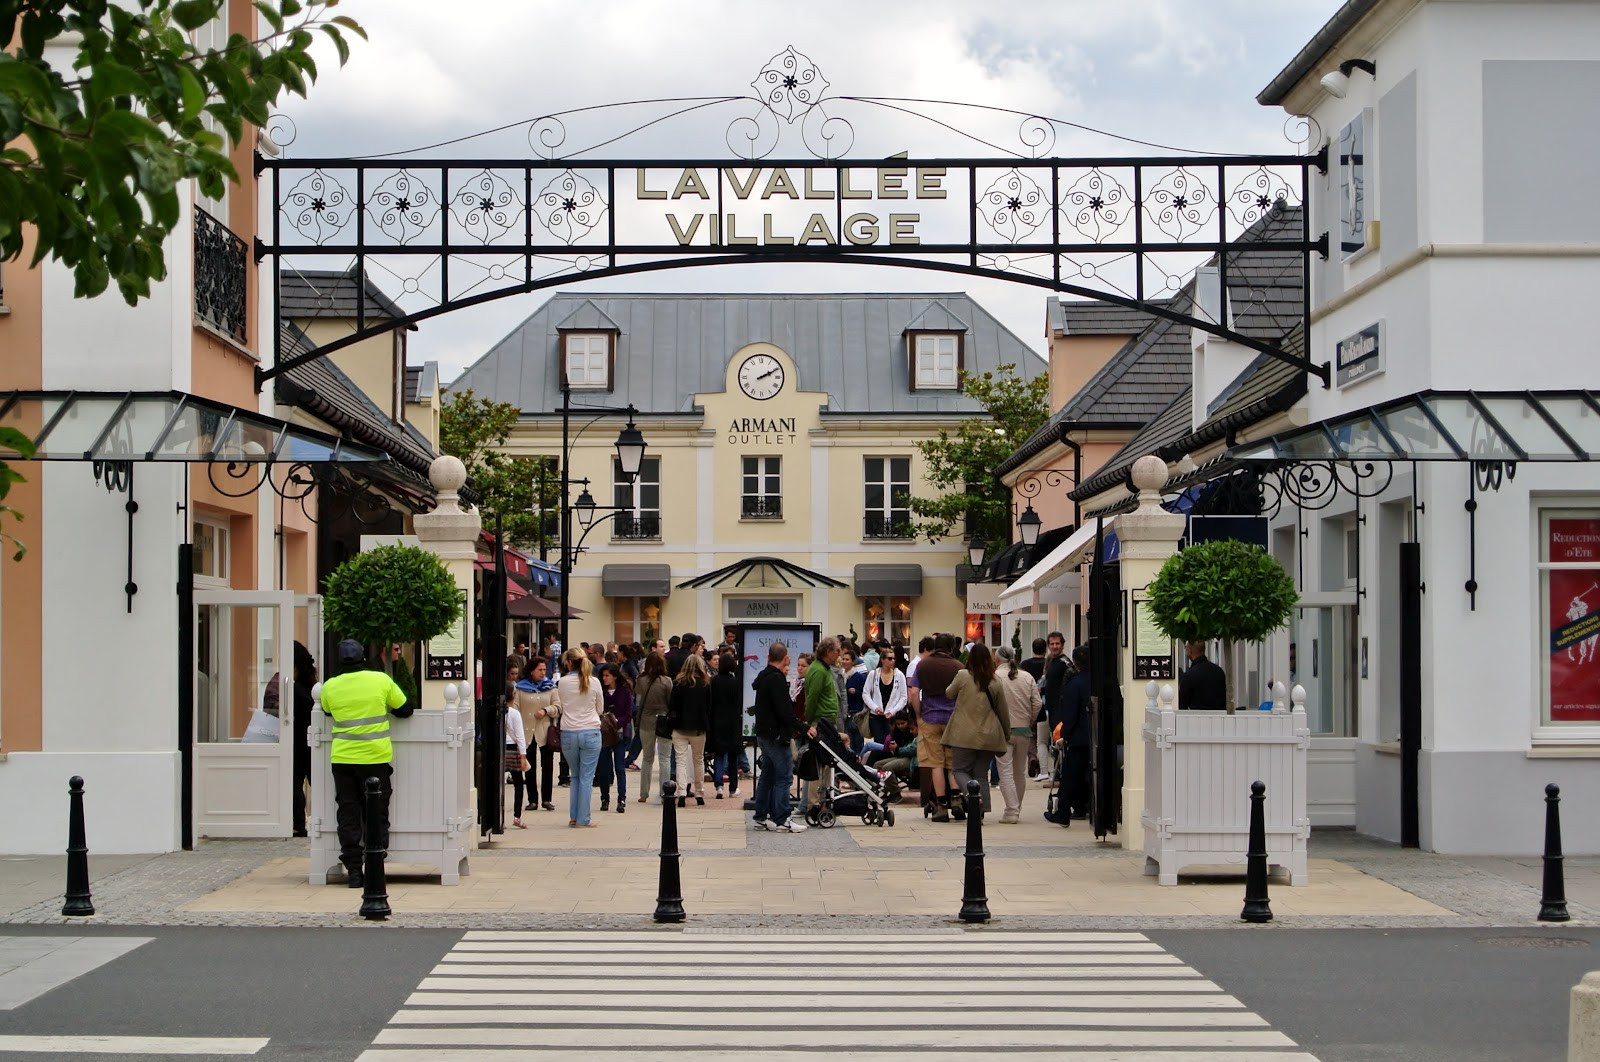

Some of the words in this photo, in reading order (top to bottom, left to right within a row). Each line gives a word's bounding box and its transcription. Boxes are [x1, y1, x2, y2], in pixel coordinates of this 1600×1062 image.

[637, 167, 710, 200] LA
[724, 151, 947, 200] VALLÉE
[665, 212, 921, 246] VILLAGE
[729, 418, 796, 433] ARMANI
[728, 435, 796, 444] OUTLET
[972, 602, 1000, 610] MaxMar
